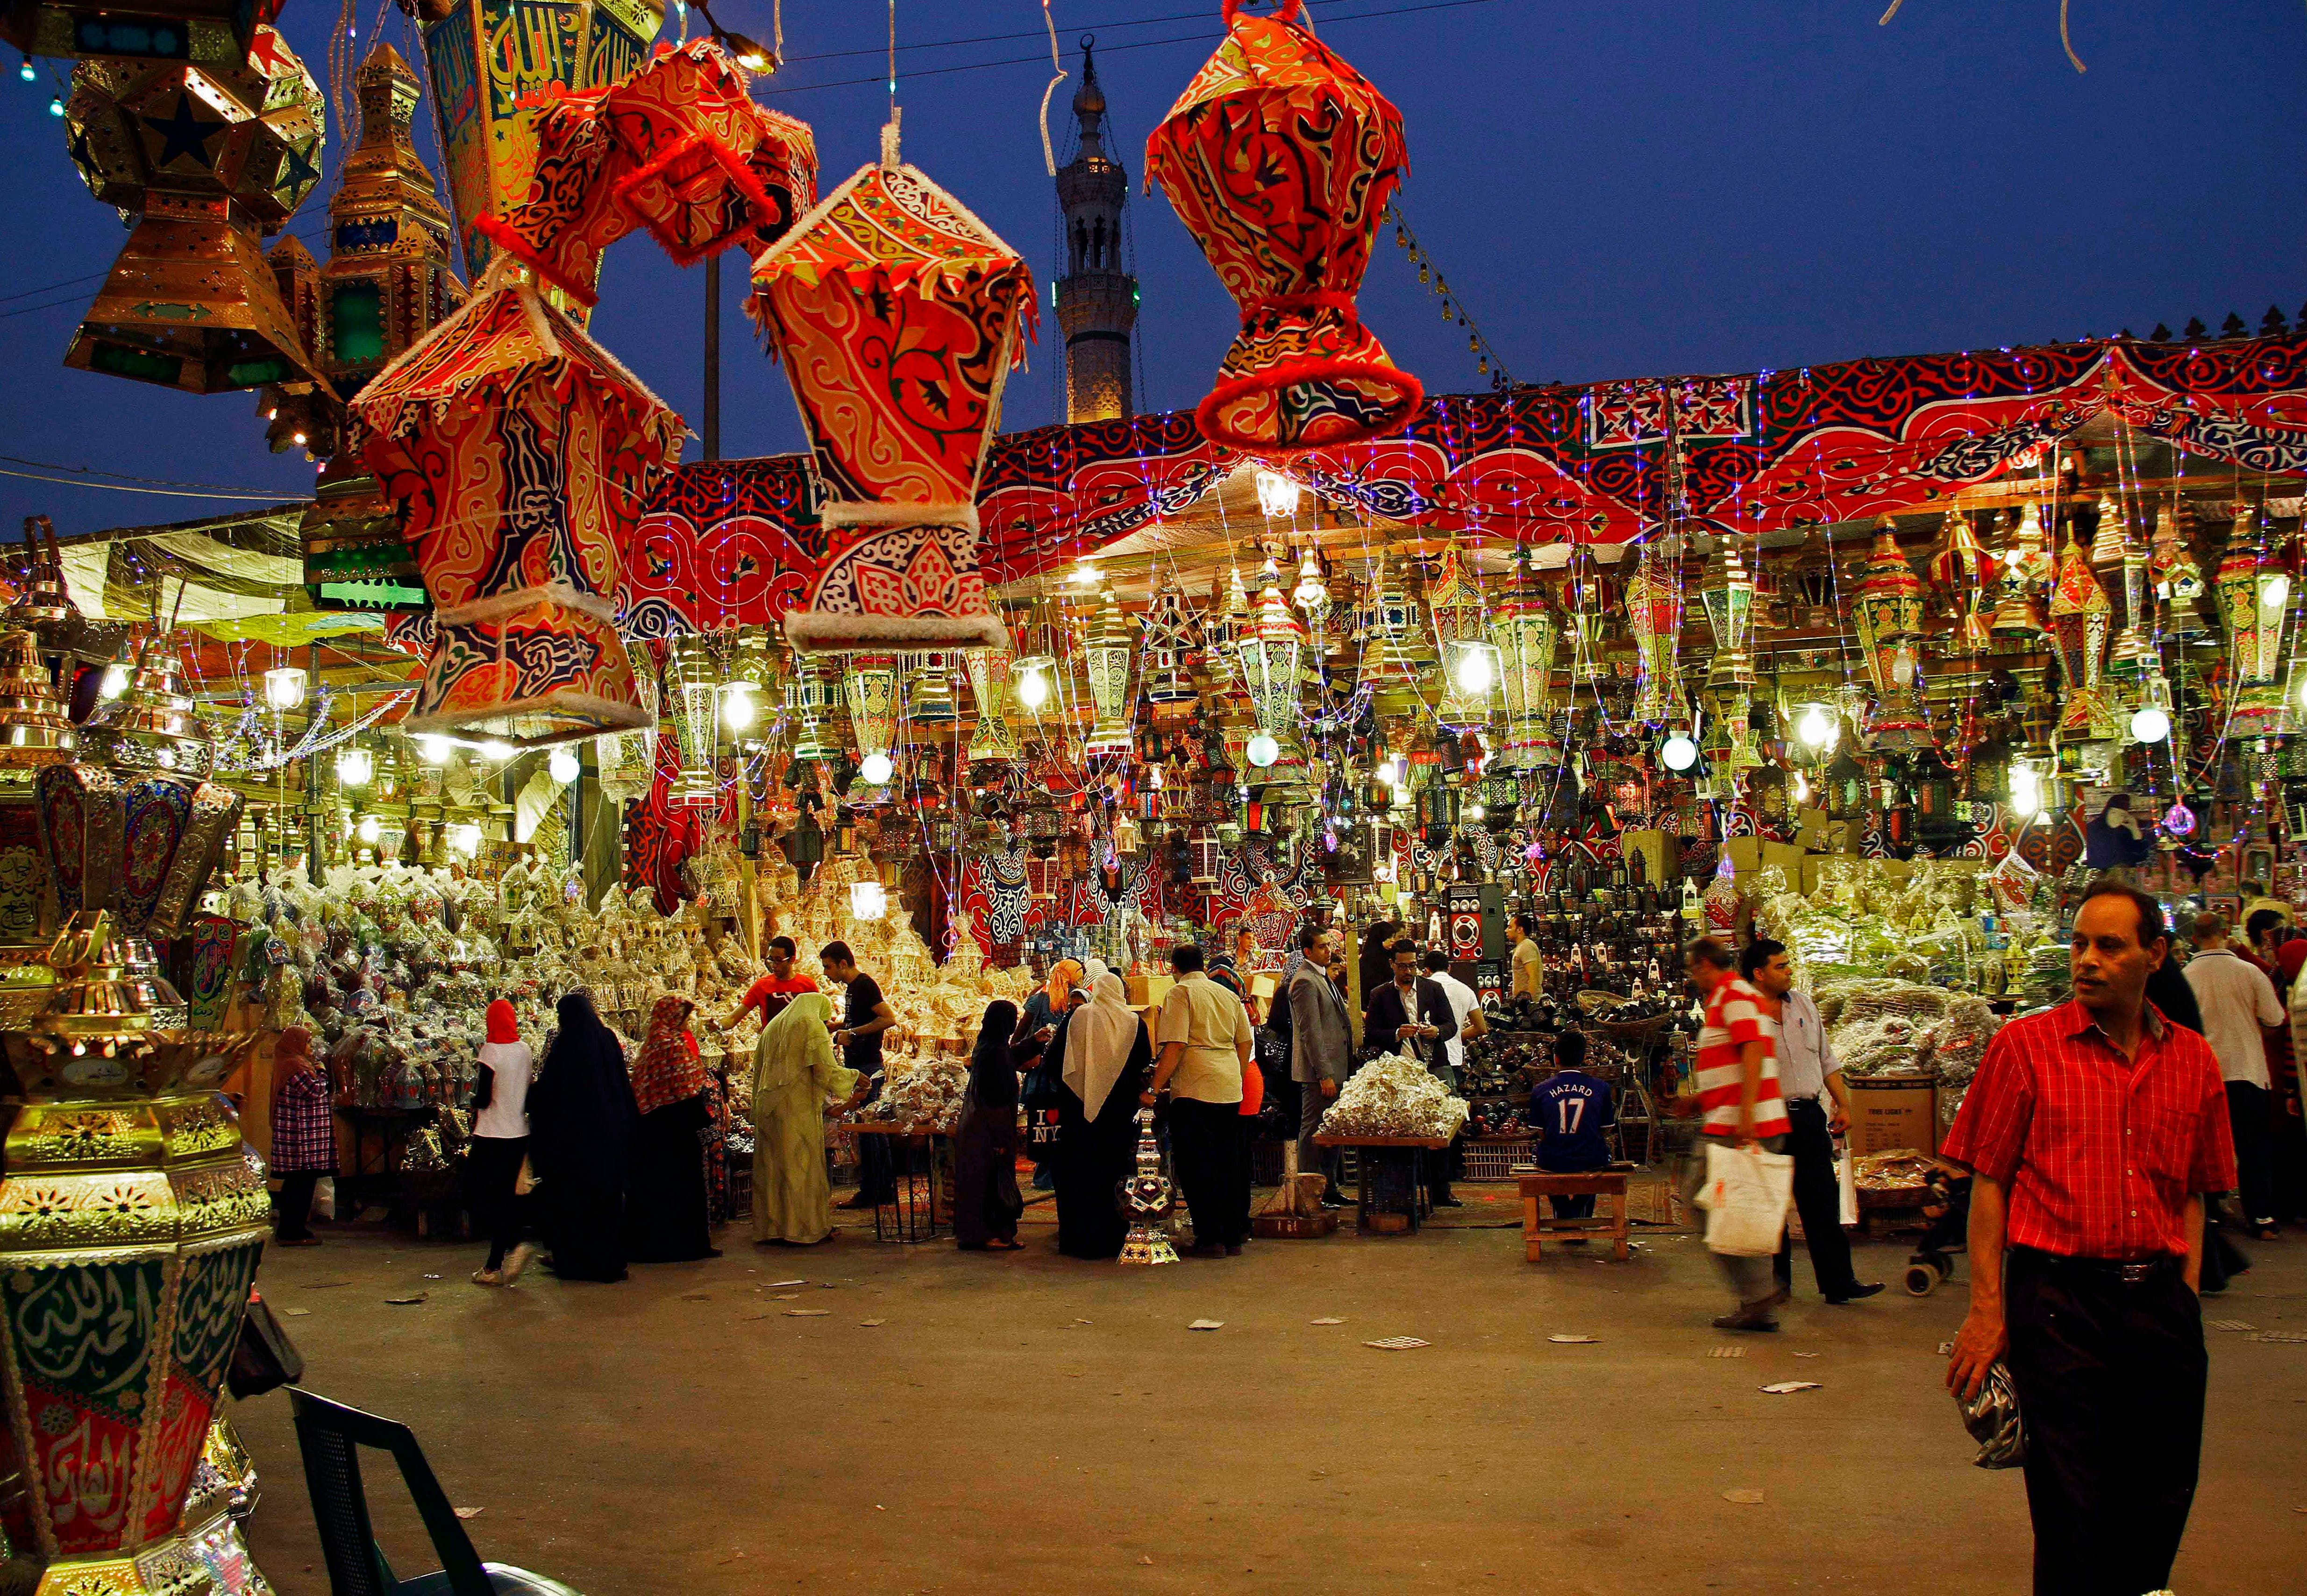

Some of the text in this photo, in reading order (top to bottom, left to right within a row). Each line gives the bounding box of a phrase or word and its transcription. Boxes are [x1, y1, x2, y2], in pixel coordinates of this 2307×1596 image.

[1549, 1084, 1593, 1098] HAZARD
[1037, 1110, 1046, 1125] I
[1558, 1098, 1585, 1135] 17
[1033, 1125, 1061, 1142] NY
